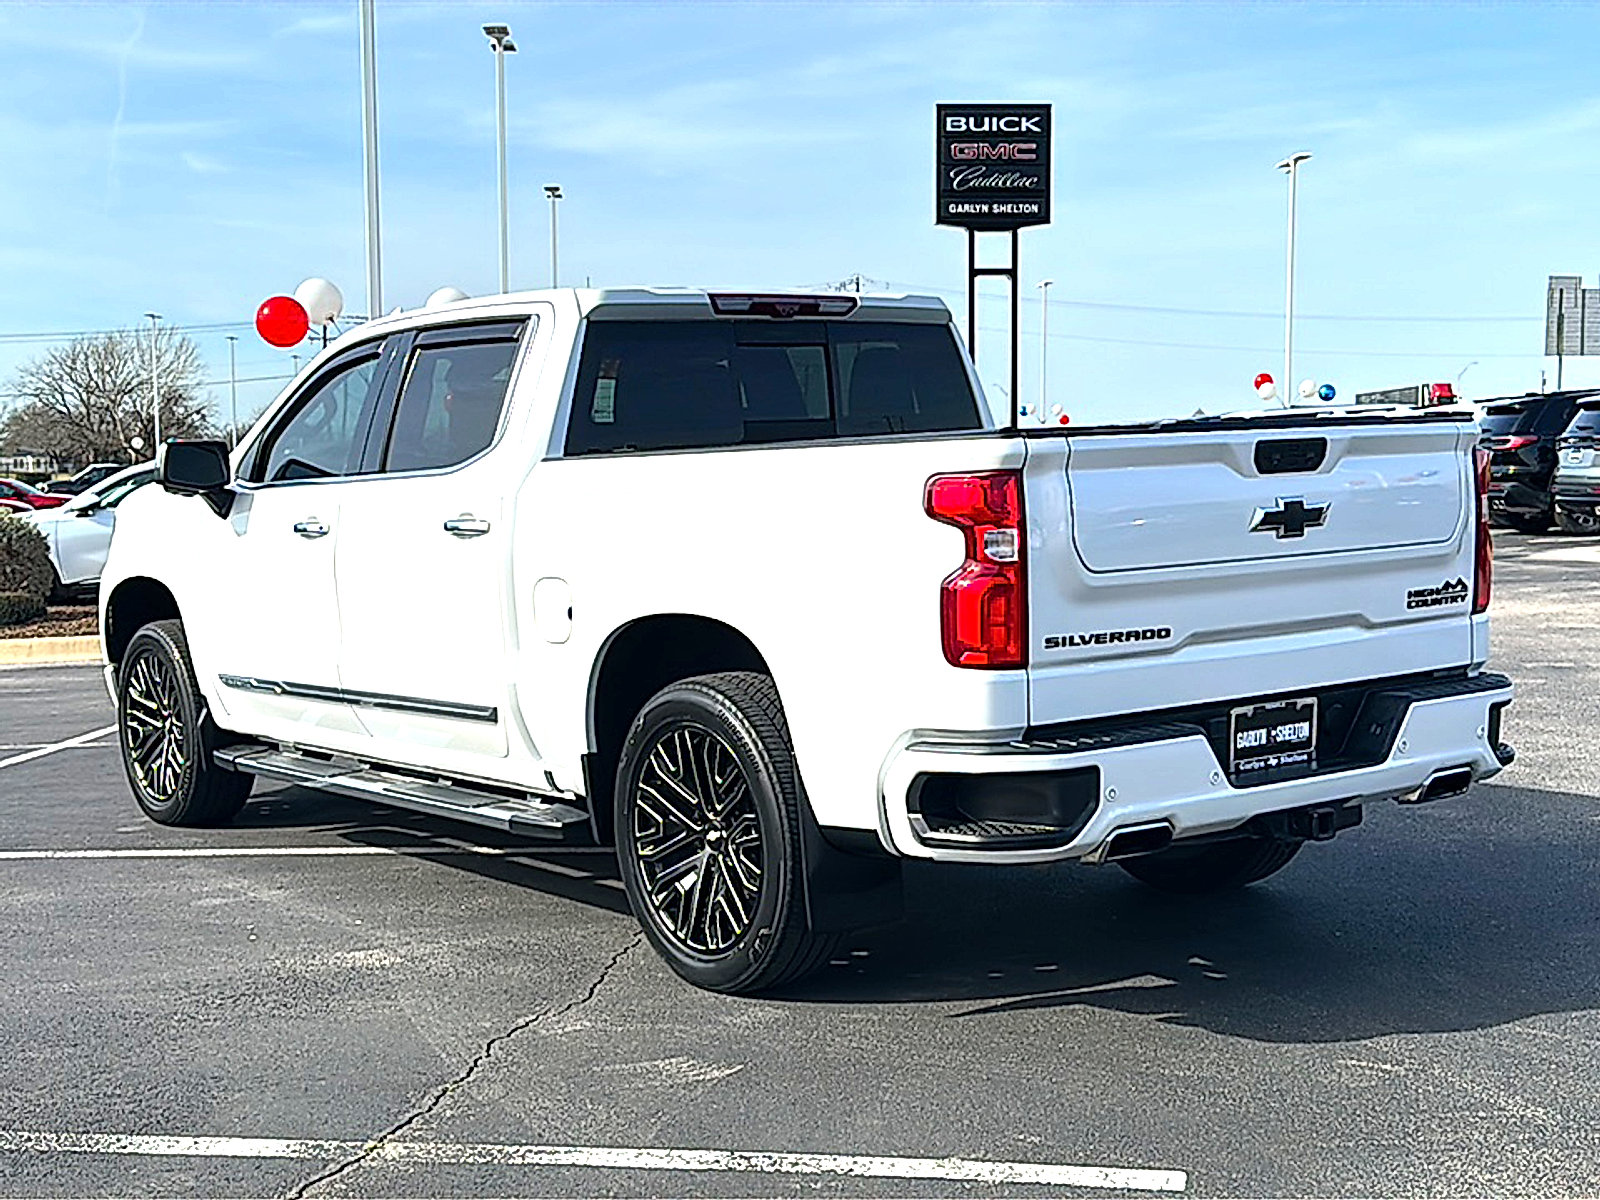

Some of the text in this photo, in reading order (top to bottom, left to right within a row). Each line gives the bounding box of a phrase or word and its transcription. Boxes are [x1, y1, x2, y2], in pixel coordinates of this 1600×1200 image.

[945, 116, 1042, 132] BUICK
[951, 143, 1037, 159] GMC
[950, 165, 1038, 191] Cadillac
[949, 203, 1039, 214] GARLYN SHELTON
[1407, 593, 1468, 609] COUNTRY
[1044, 628, 1171, 649] SILVERADO
